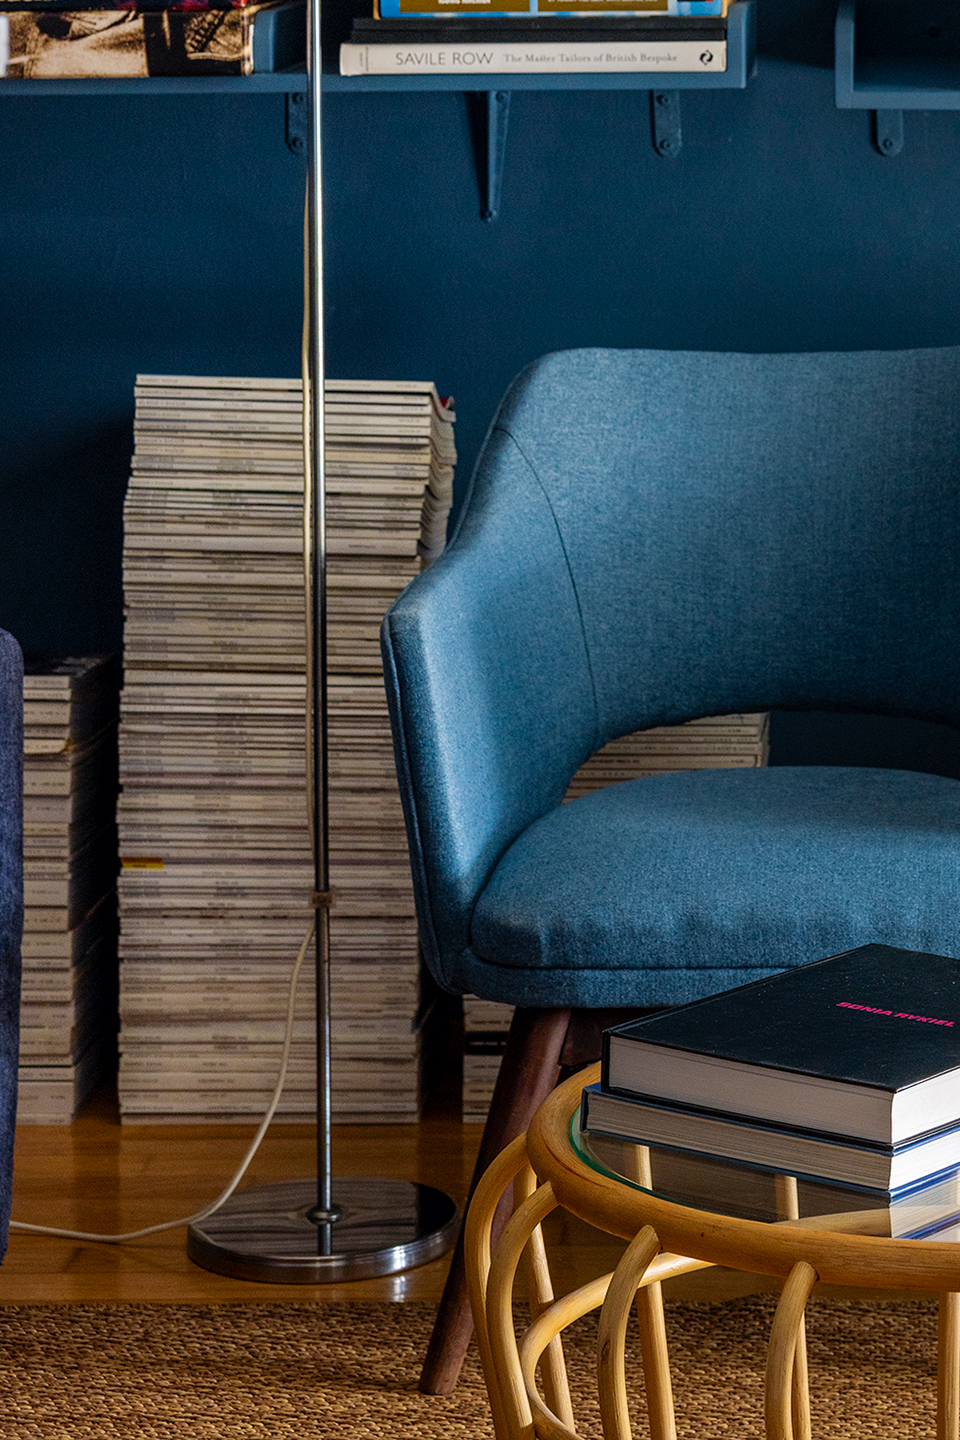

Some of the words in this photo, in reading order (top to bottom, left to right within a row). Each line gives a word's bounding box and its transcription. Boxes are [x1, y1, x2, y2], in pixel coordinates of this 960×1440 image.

[396, 53, 446, 65] SAVILE
[452, 52, 494, 65] ROW
[504, 54, 521, 62] The
[526, 54, 556, 62] Master
[559, 53, 590, 62] Tailors
[592, 53, 602, 62] of
[606, 53, 638, 62] British
[640, 54, 677, 64] Bespoke
[836, 1002, 892, 1015] SONIA
[894, 1013, 954, 1027] RYKIEL
